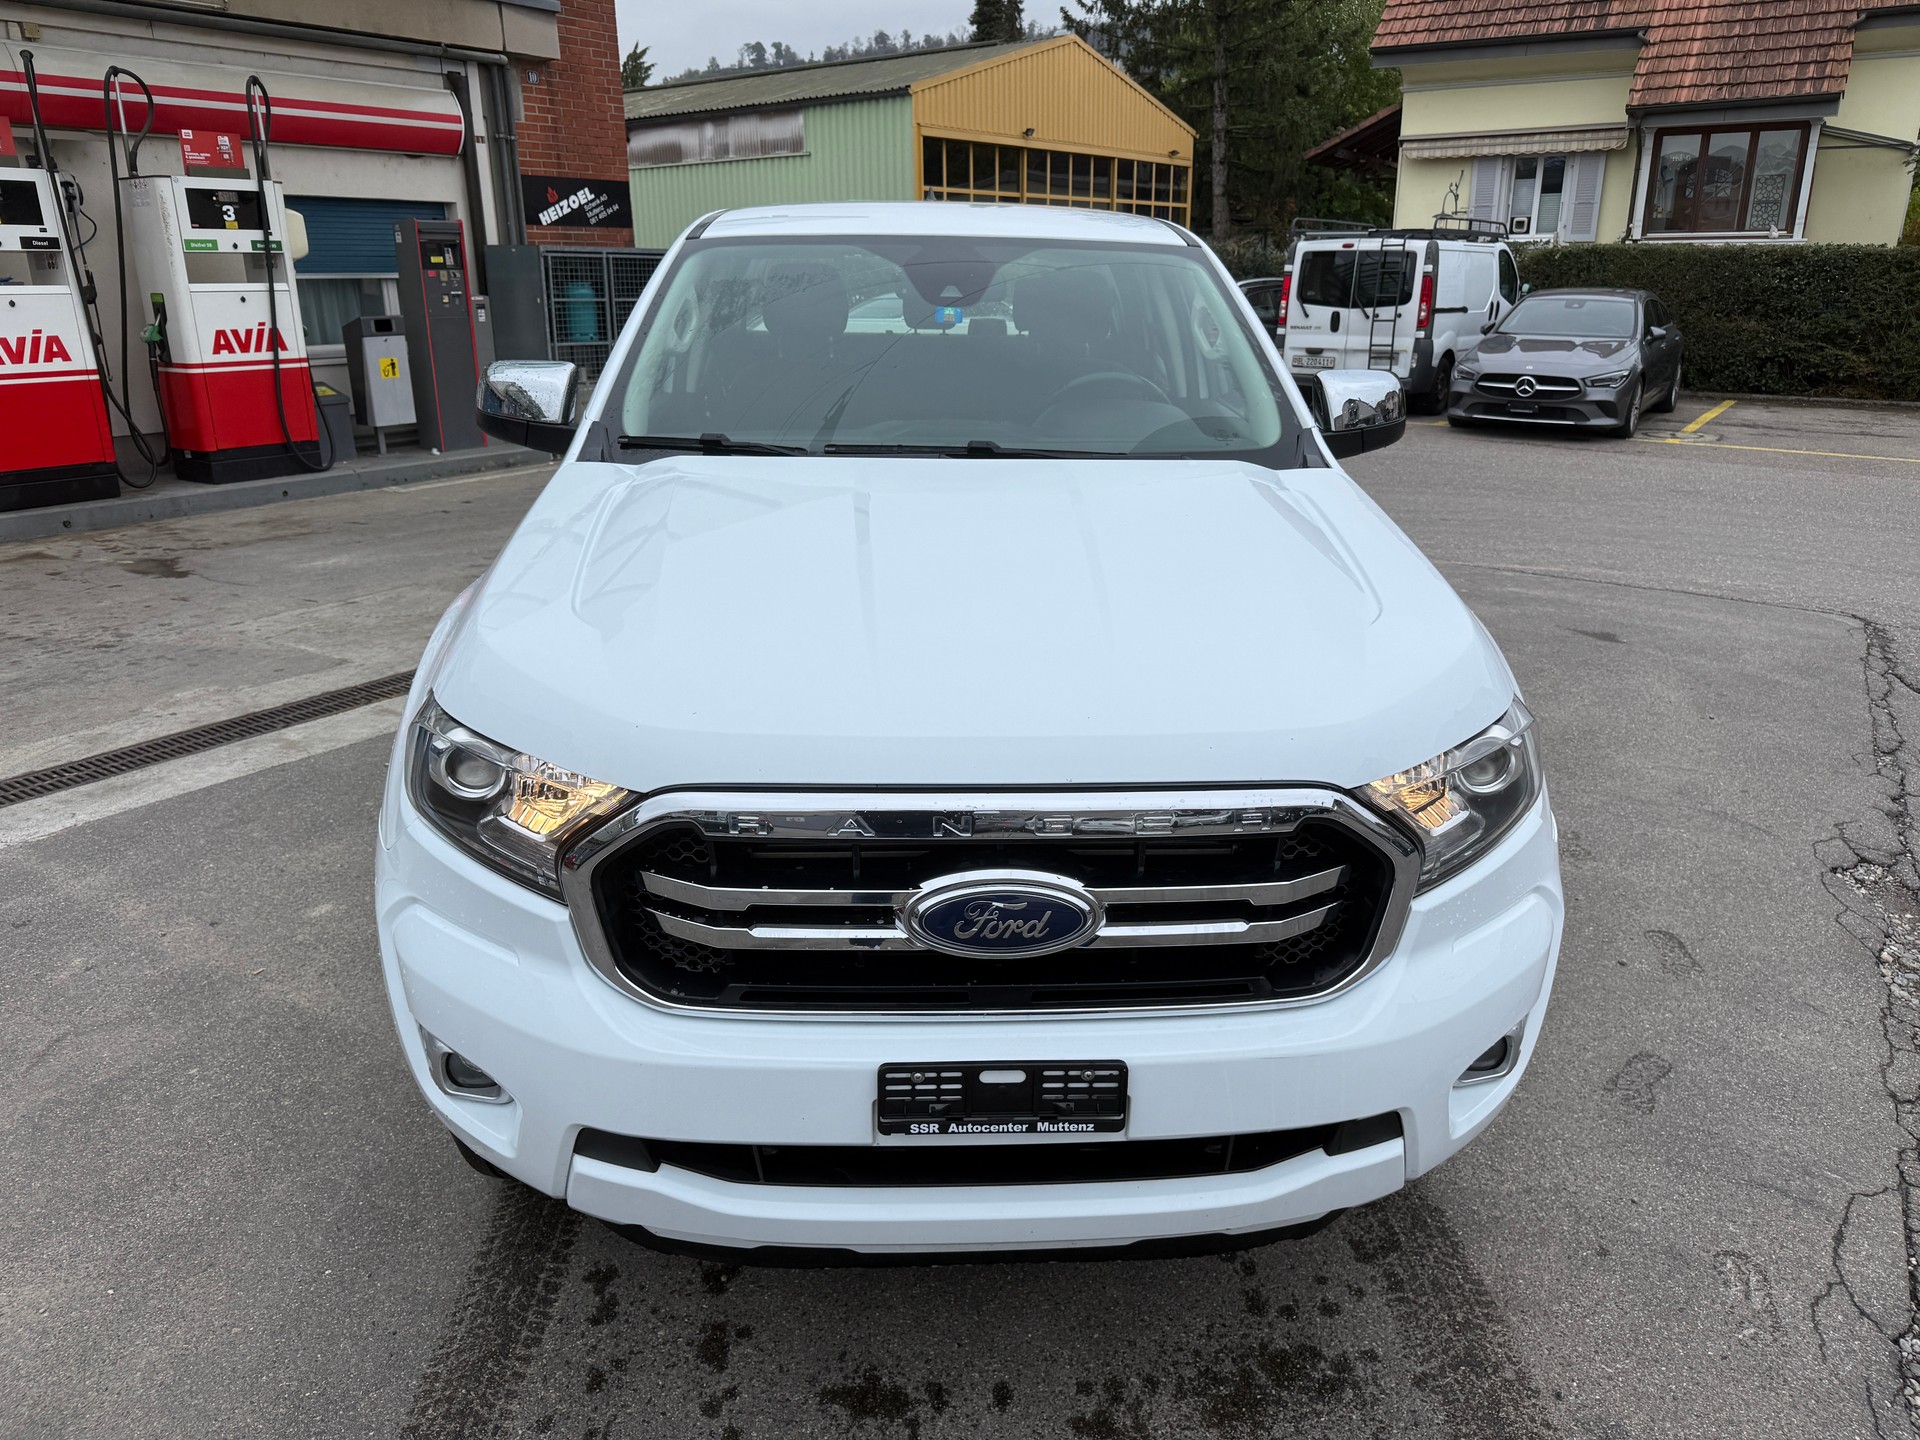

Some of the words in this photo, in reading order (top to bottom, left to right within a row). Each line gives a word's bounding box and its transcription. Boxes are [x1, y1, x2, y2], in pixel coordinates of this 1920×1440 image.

[528, 71, 538, 83] 10
[222, 205, 235, 221] 3
[538, 187, 596, 226] HEIZOEL
[0, 329, 73, 366] VIA
[212, 322, 289, 355] AVIA
[729, 811, 1271, 837] RANGER
[954, 900, 1052, 939] Ford
[909, 1123, 940, 1134] SSR
[948, 1122, 1029, 1133] Autocenter
[1036, 1121, 1095, 1133] Muttenz
